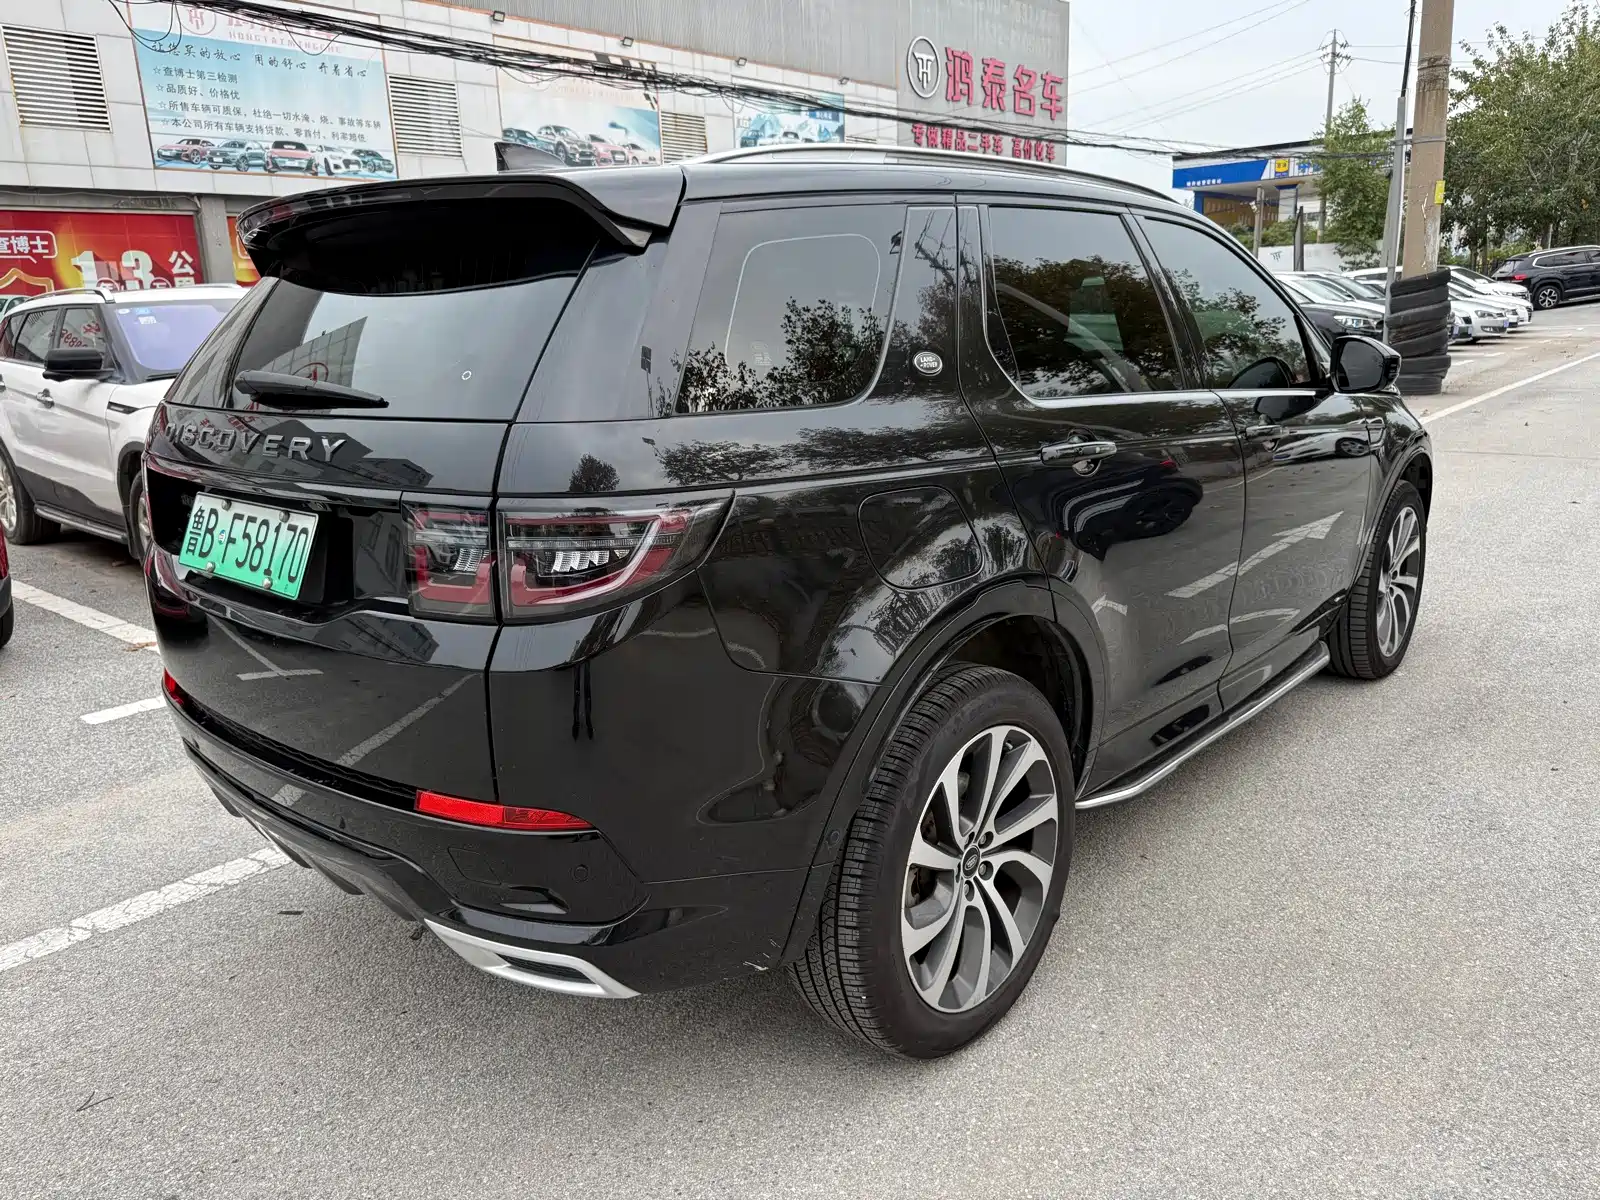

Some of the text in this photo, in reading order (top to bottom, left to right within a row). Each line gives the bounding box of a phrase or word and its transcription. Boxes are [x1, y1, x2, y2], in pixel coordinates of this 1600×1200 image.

[166, 83, 240, 100] 品质好、价格优
[944, 47, 1065, 120] 鸿泰名车
[165, 422, 347, 462] DISCOVERY
